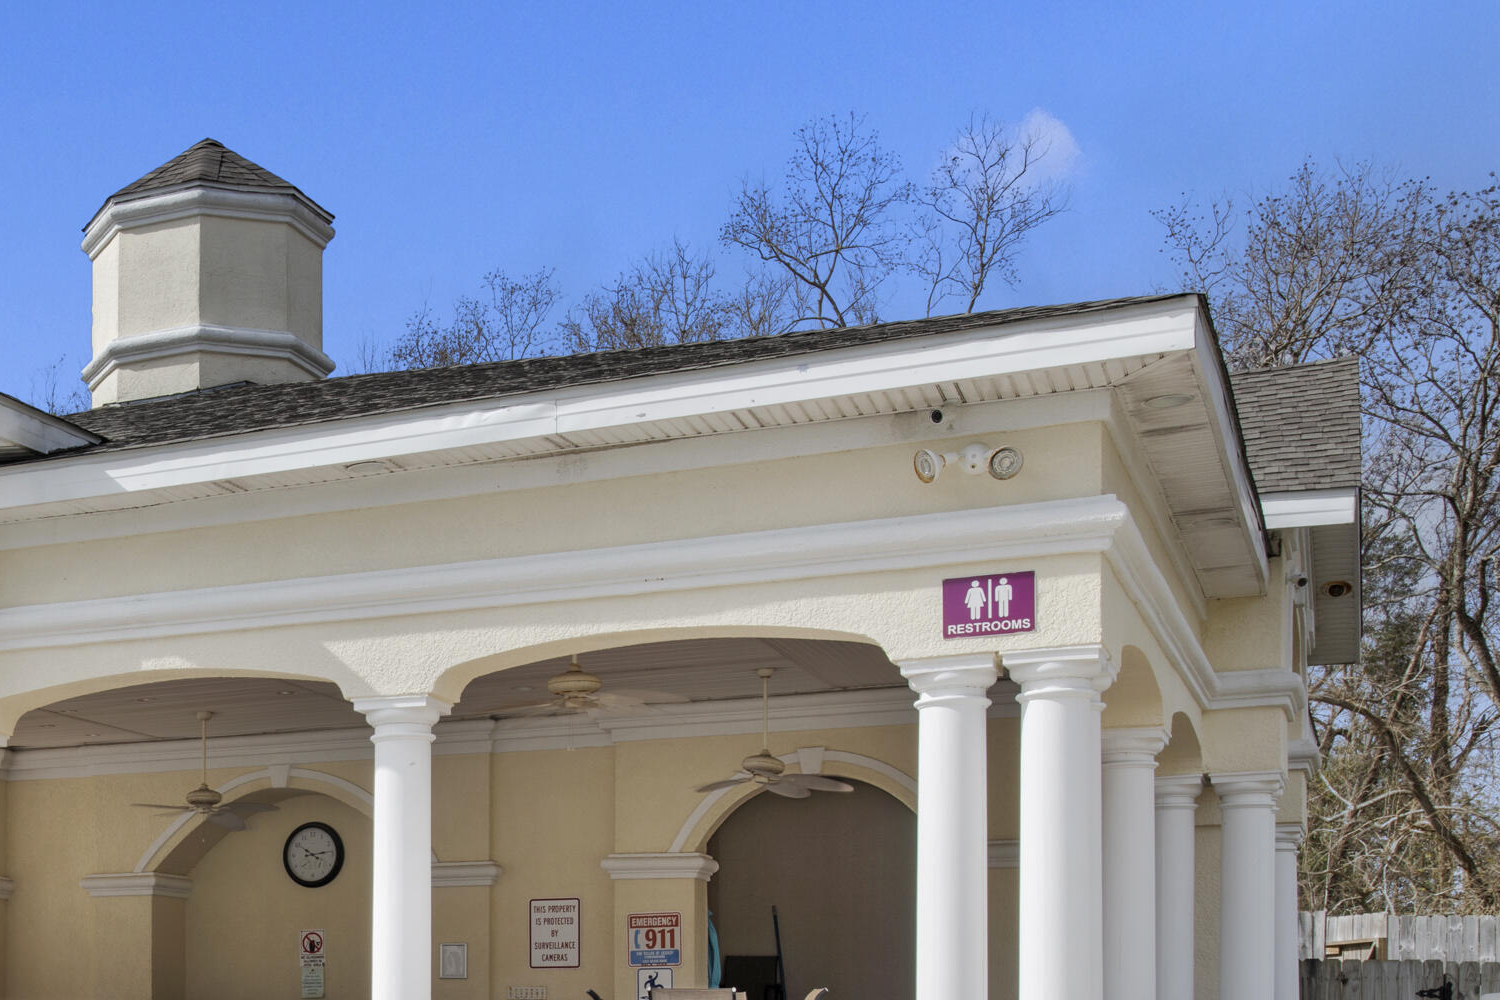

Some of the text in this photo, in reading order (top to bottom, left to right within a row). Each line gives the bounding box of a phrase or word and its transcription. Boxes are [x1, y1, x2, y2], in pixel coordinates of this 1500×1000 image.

[947, 618, 1031, 635] RESTROOMS
[534, 905, 576, 913] THIS PROPERTY
[535, 917, 574, 926] IS PROTECTED
[631, 916, 677, 927] EMERGENCY
[551, 929, 559, 937] BY
[644, 928, 675, 949] 911
[534, 941, 576, 950] SURVEILLANCE
[541, 953, 568, 962] CAMERAS
